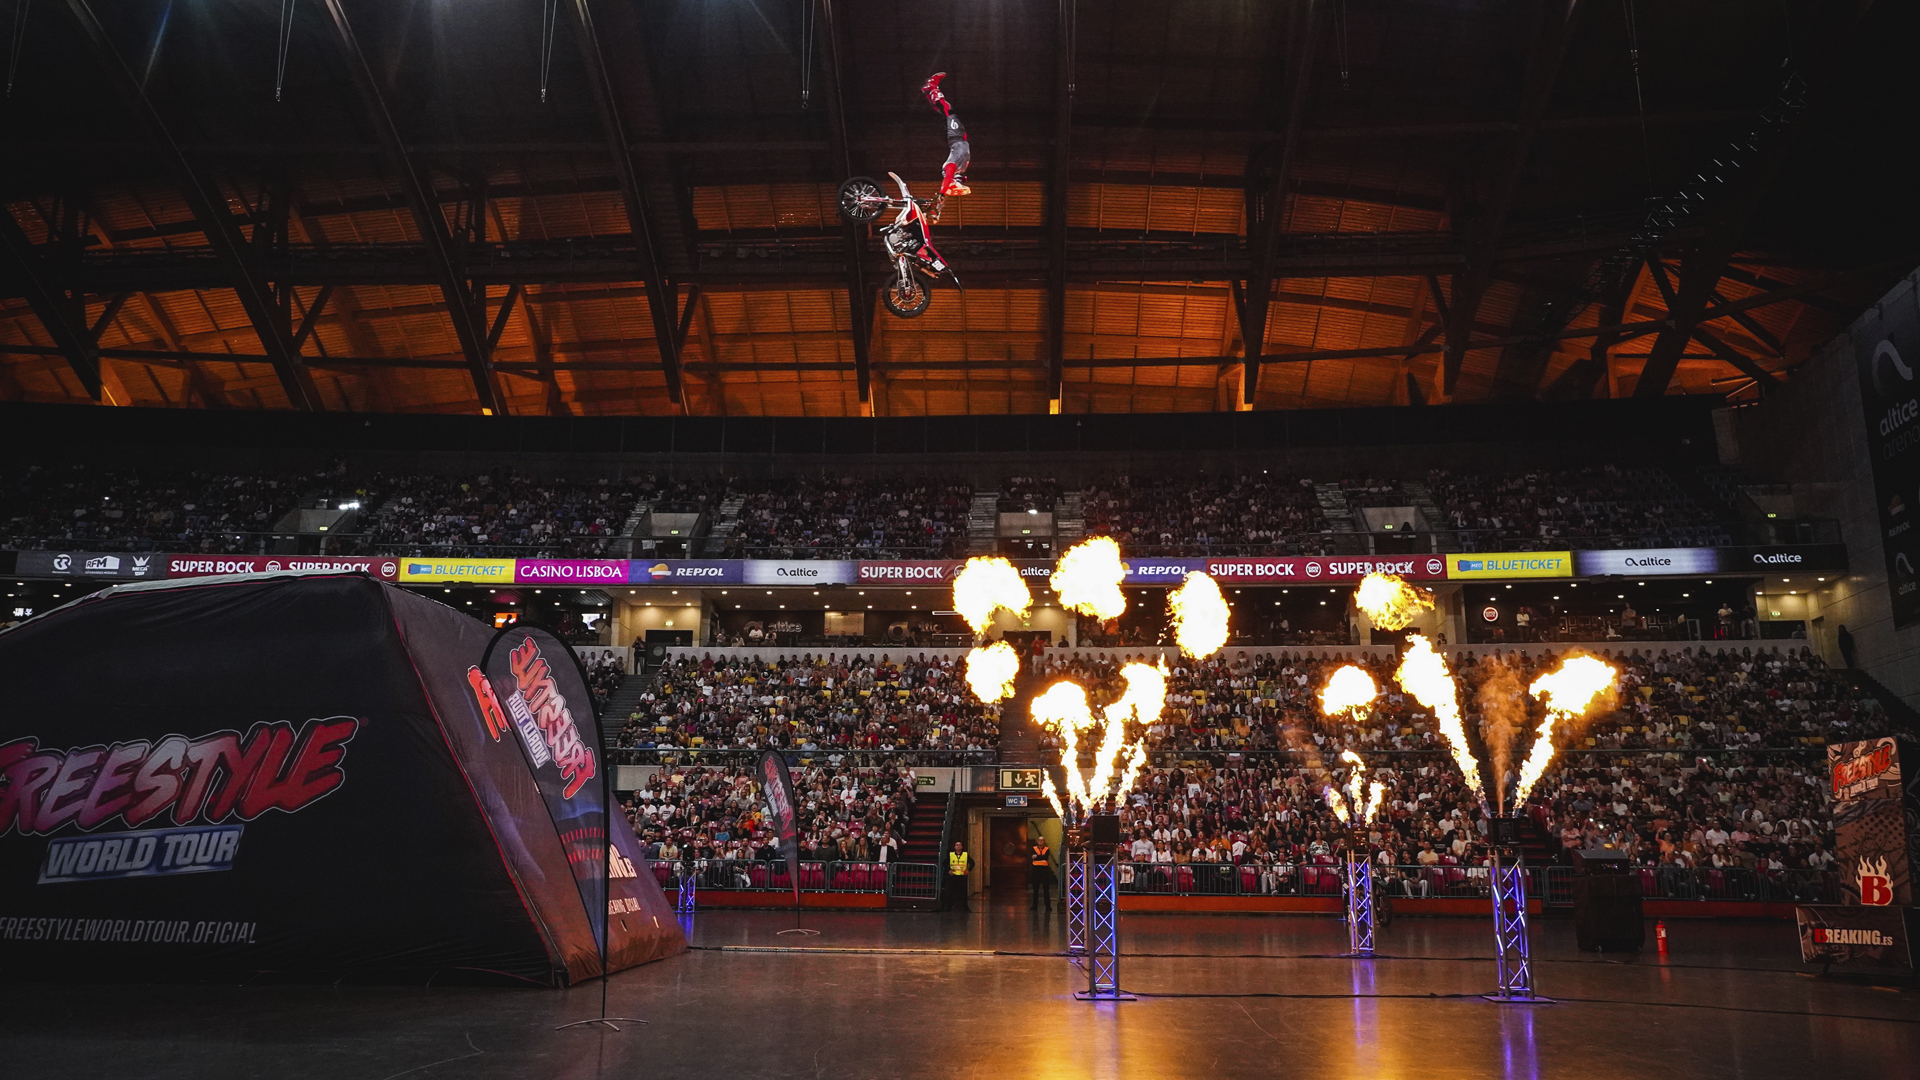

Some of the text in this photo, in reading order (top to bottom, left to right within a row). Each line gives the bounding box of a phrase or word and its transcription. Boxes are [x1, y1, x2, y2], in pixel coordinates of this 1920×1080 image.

[1879, 399, 1918, 437] altice
[1888, 520, 1910, 538] REPSOL
[86, 557, 108, 568] RFM
[1639, 556, 1671, 567] altice
[1768, 552, 1802, 564] altice
[170, 560, 214, 573] SUPER
[216, 561, 255, 574] BOCK
[434, 564, 506, 576] BLUETICKET
[1138, 566, 1188, 575] REPSOL
[1210, 564, 1253, 576] SUPER
[1256, 564, 1295, 576] BOCK
[1329, 562, 1373, 576] SUPER
[1376, 561, 1415, 574] BOCK
[1486, 558, 1562, 572] BLUETICKET
[520, 566, 622, 578] CASINO LISBOA
[676, 568, 724, 577] REPSOL
[789, 568, 818, 577] altice
[861, 566, 903, 578] SUPER
[905, 566, 944, 578] BOCK
[1020, 567, 1050, 576] altice
[1898, 581, 1917, 596] altice
[47, 830, 240, 877] WORLD TOUR
[1814, 928, 1893, 946] BREAKING.ES
